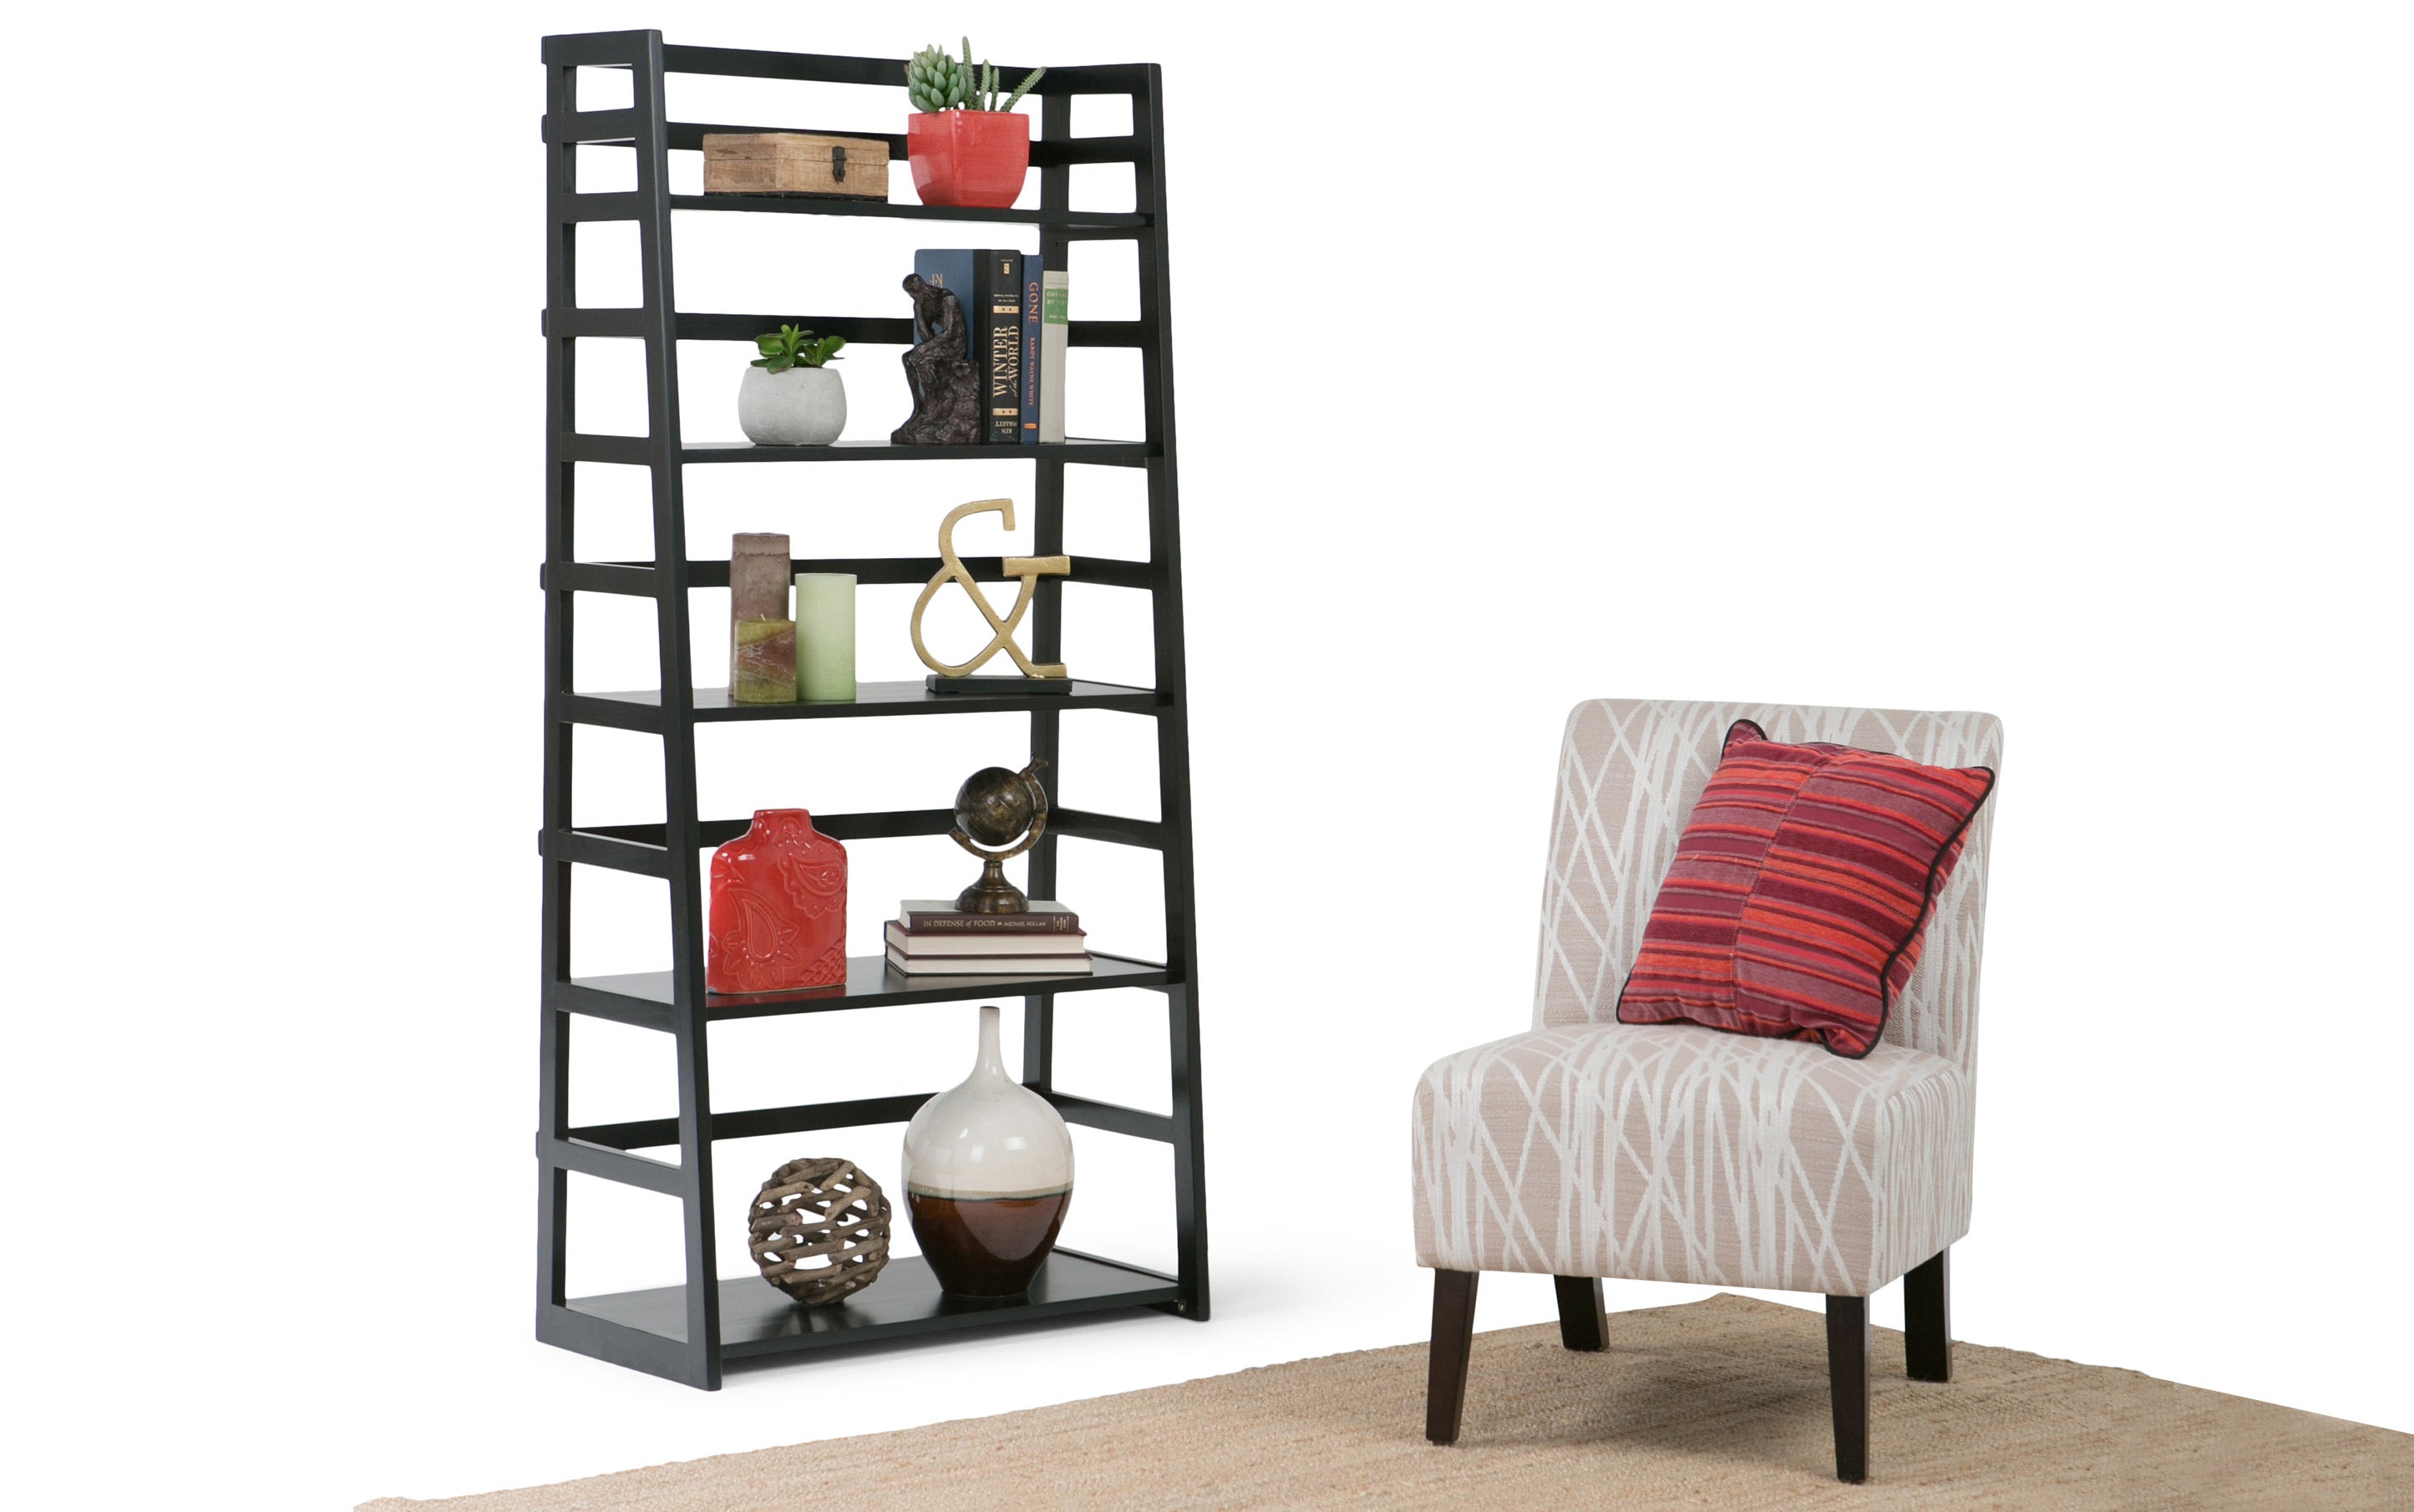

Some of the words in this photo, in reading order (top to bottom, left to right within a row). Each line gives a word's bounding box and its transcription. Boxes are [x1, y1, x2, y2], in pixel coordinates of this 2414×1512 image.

[1028, 282, 1039, 324] GONE
[992, 326, 1008, 398] WINTER
[1007, 325, 1019, 379] WORLD
[965, 920, 972, 929] of
